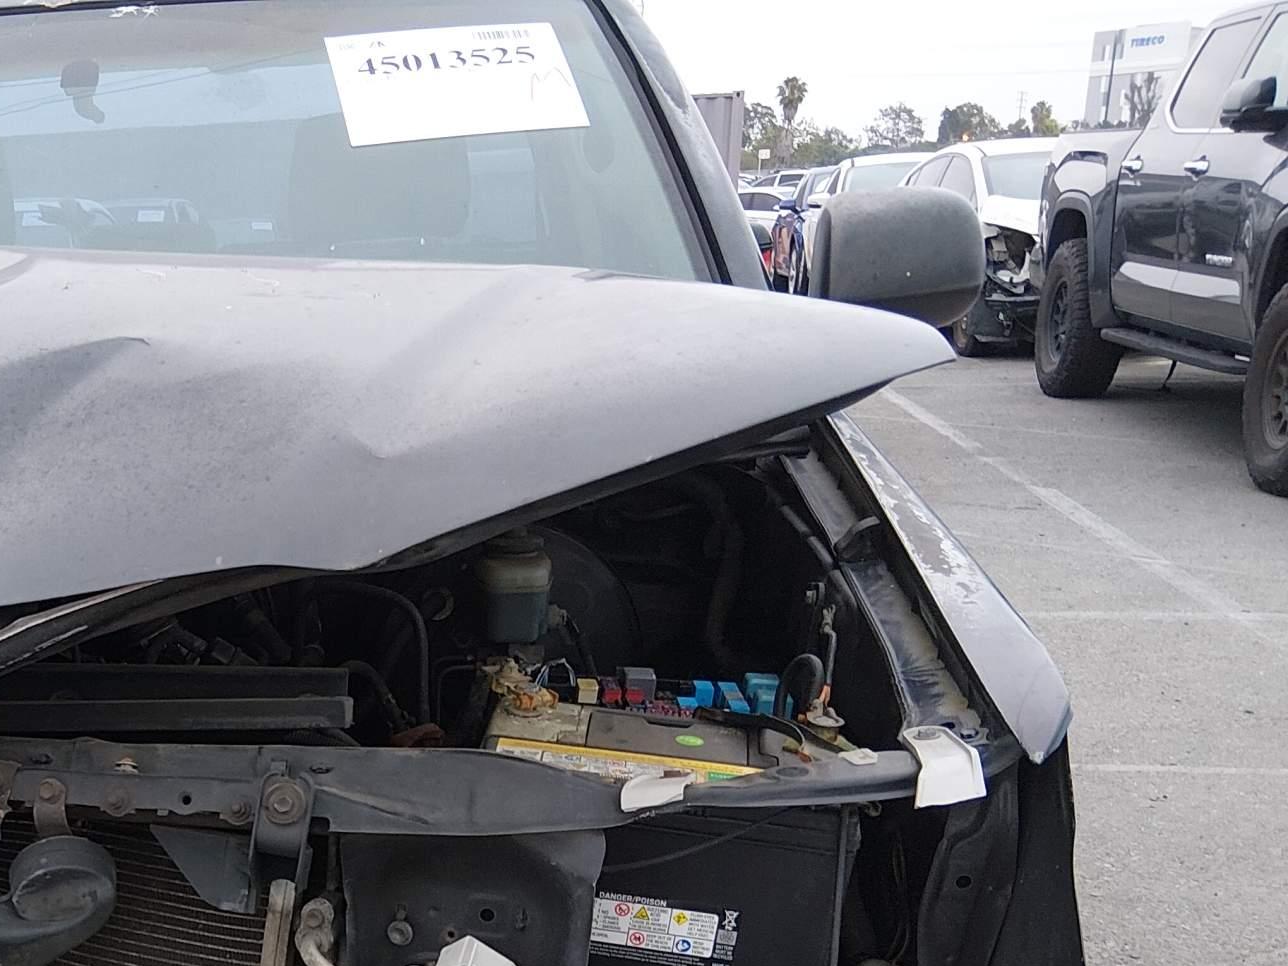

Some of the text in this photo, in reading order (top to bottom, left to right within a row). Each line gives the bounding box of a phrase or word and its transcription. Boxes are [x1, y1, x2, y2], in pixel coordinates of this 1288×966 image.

[1130, 35, 1165, 47] TIRECO
[358, 46, 536, 75] 45013525
[599, 891, 668, 907] DANGER/POISON
